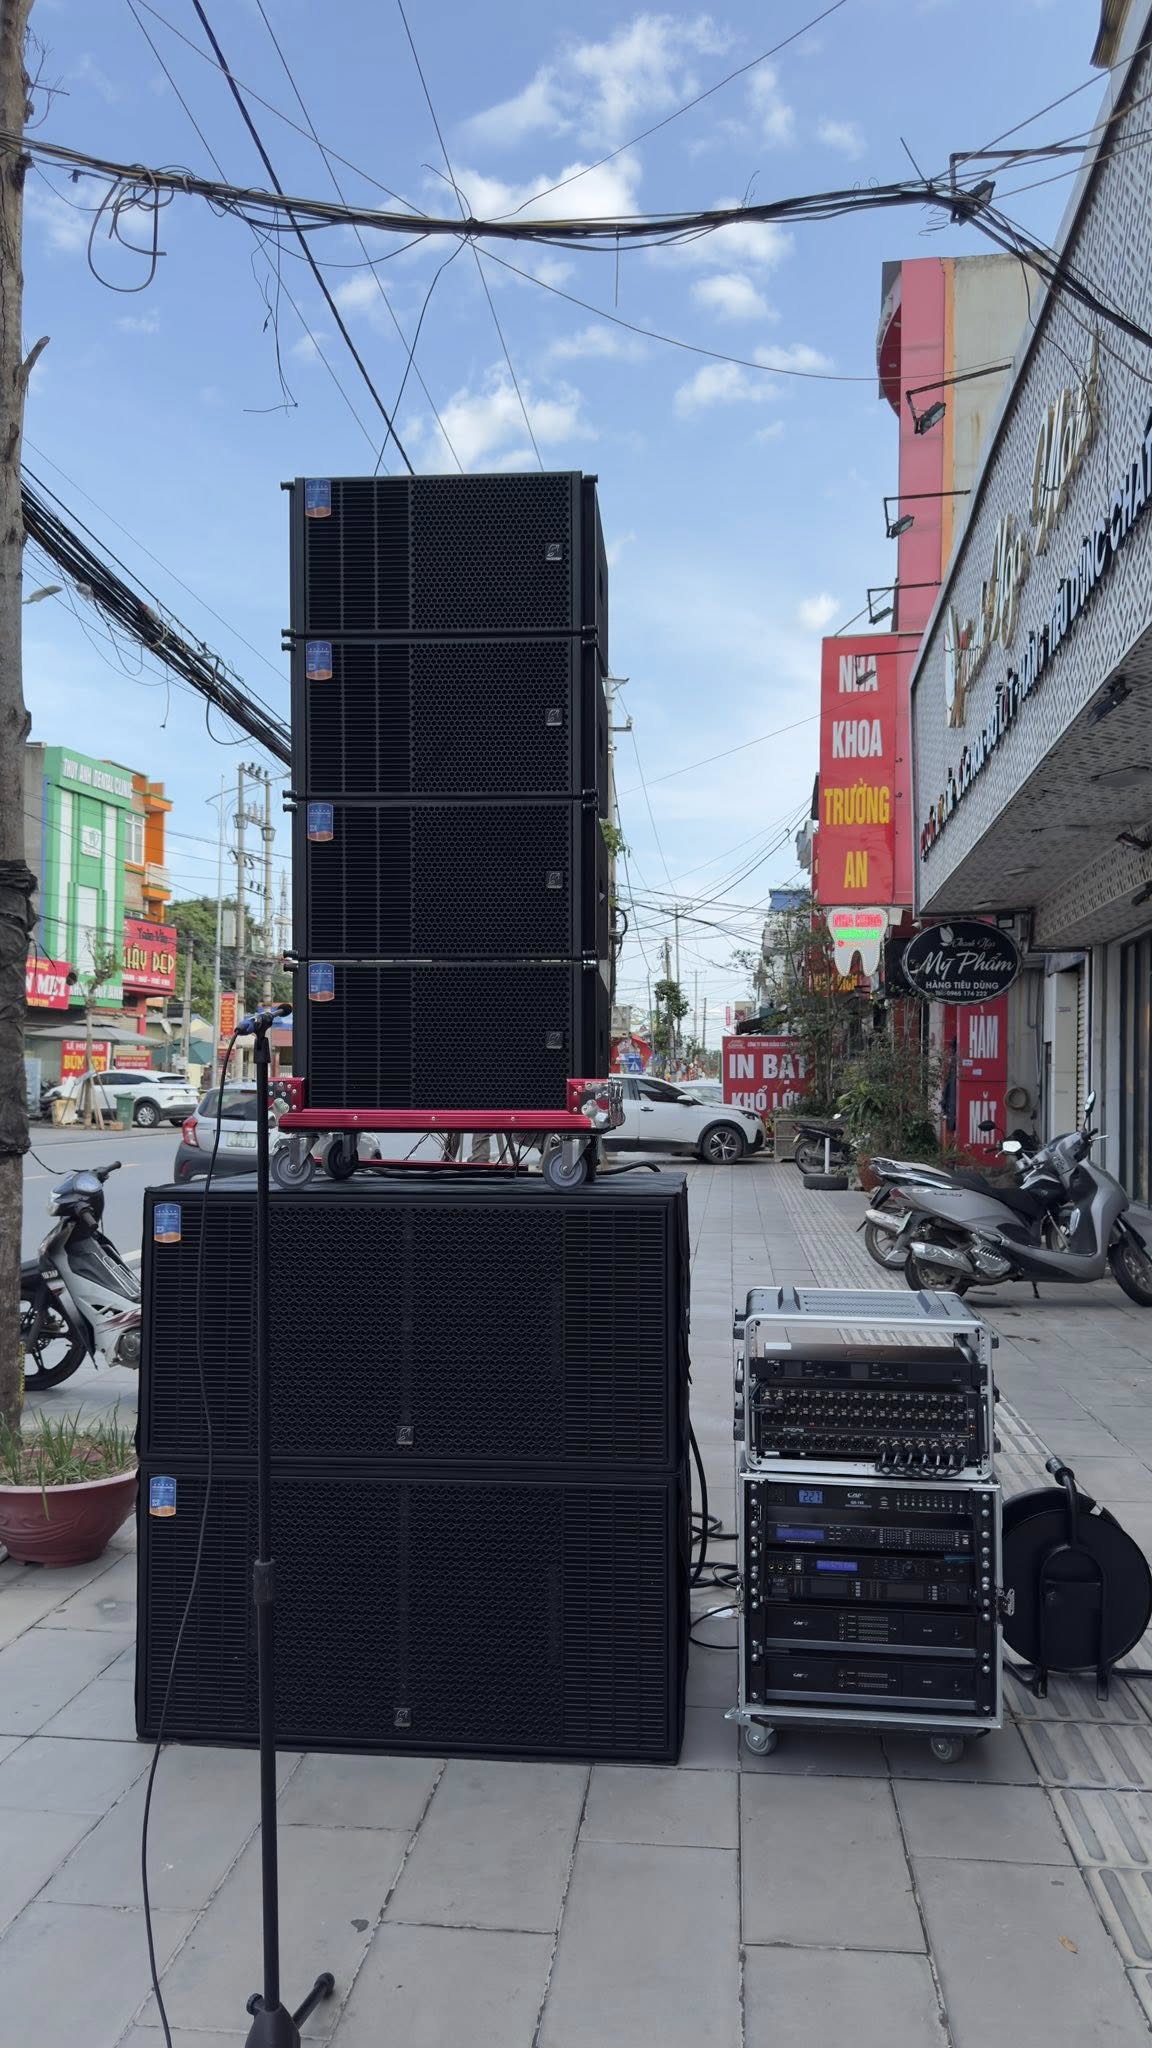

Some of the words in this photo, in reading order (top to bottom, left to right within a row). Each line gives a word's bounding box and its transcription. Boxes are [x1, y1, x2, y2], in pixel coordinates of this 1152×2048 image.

[839, 655, 878, 693] NHA
[832, 719, 883, 758] KHOA
[824, 778, 890, 826] TRƯỜNG
[844, 851, 868, 888] AN
[956, 950, 1016, 975] Phẩm
[925, 980, 952, 990] HÀNG
[954, 979, 971, 990] TIÊU
[973, 980, 999, 990] DÙNG
[970, 1005, 998, 1058] HÀM
[729, 1054, 754, 1079] IN
[732, 1085, 767, 1111] KHỔ
